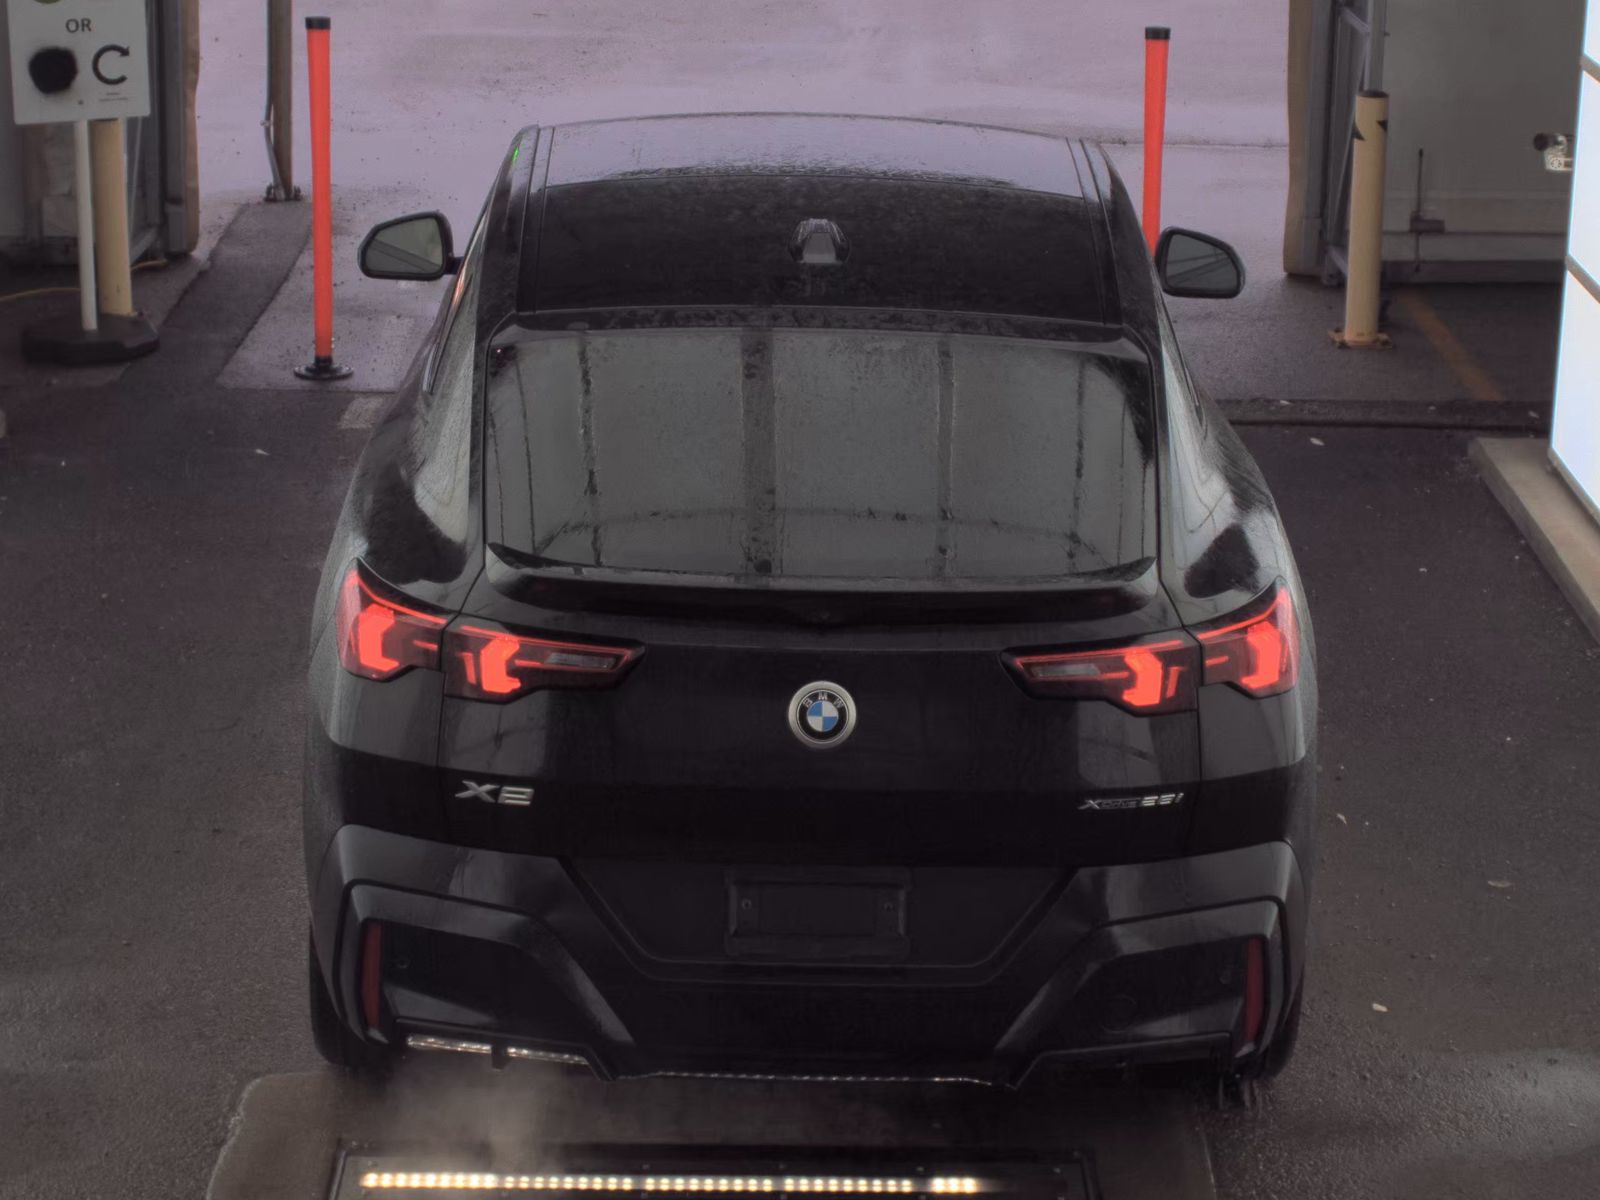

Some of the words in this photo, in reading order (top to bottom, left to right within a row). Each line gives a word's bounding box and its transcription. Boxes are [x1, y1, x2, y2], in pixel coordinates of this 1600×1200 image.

[65, 18, 92, 33] OR
[802, 692, 844, 708] BMW
[454, 780, 535, 806] X2
